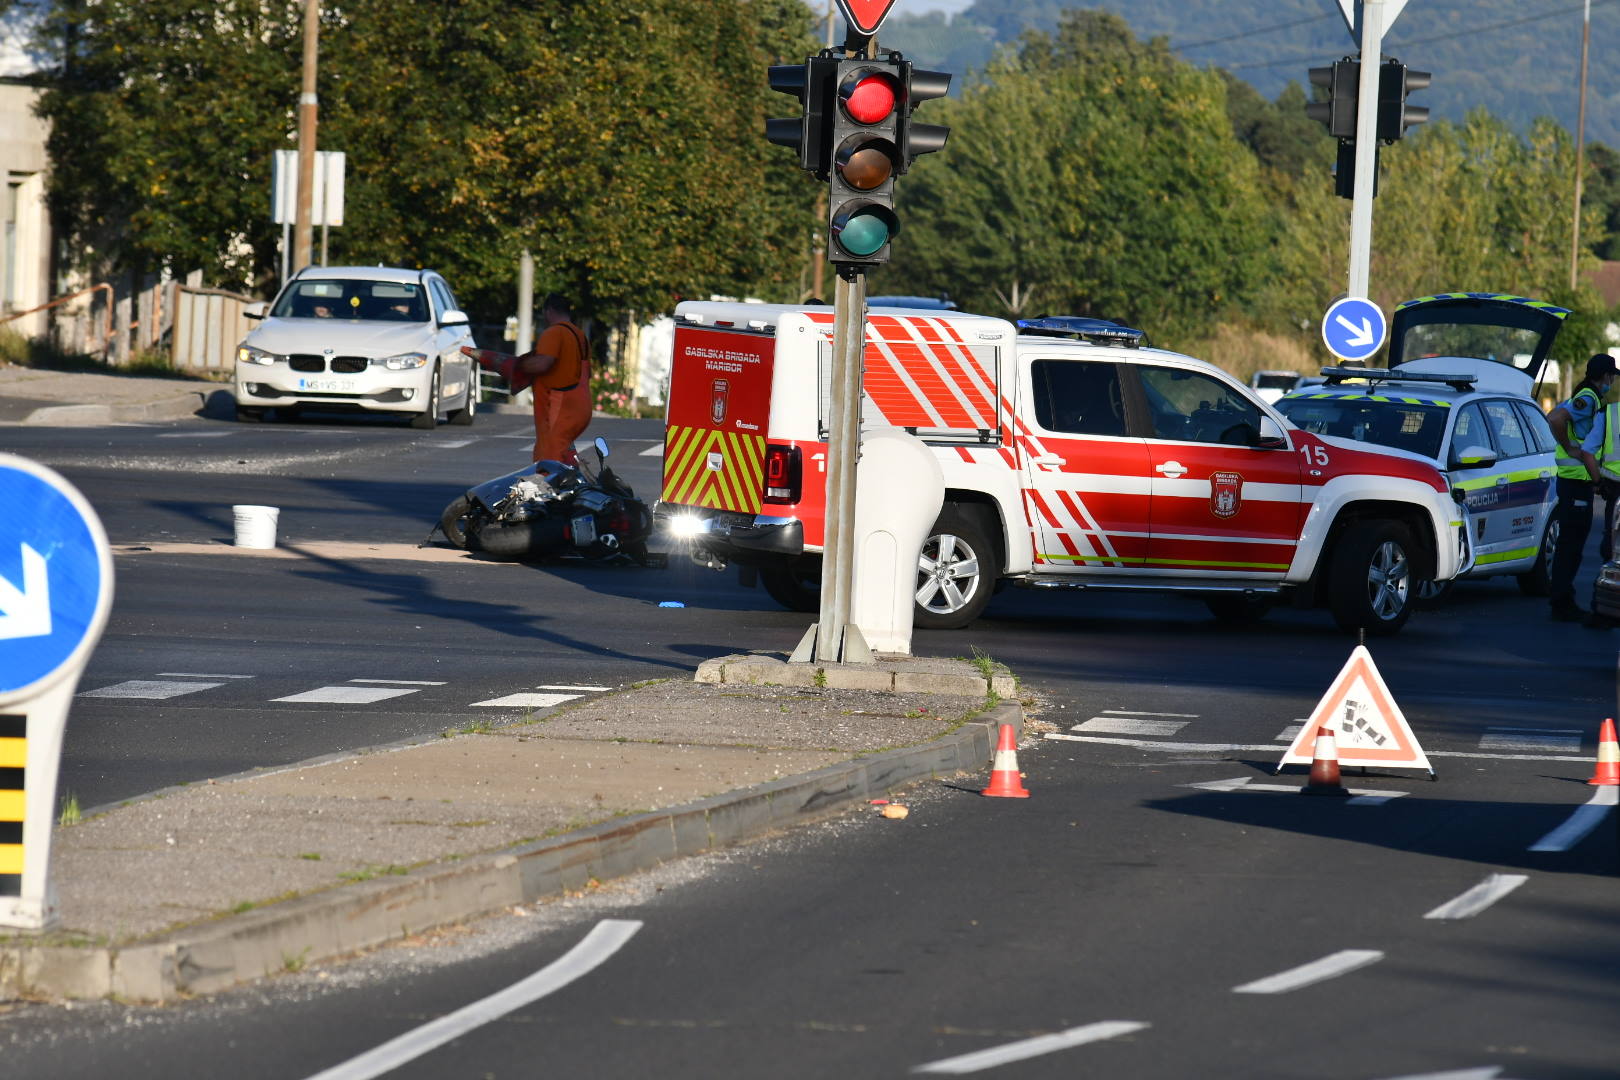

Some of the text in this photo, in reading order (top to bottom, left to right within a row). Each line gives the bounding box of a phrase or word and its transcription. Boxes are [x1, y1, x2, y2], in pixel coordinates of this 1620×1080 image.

[685, 346, 761, 364] GASILSKA BRIGADA
[705, 360, 743, 373] MARIBOR
[1300, 444, 1329, 466] 15
[1467, 492, 1499, 507] POLICIJA
